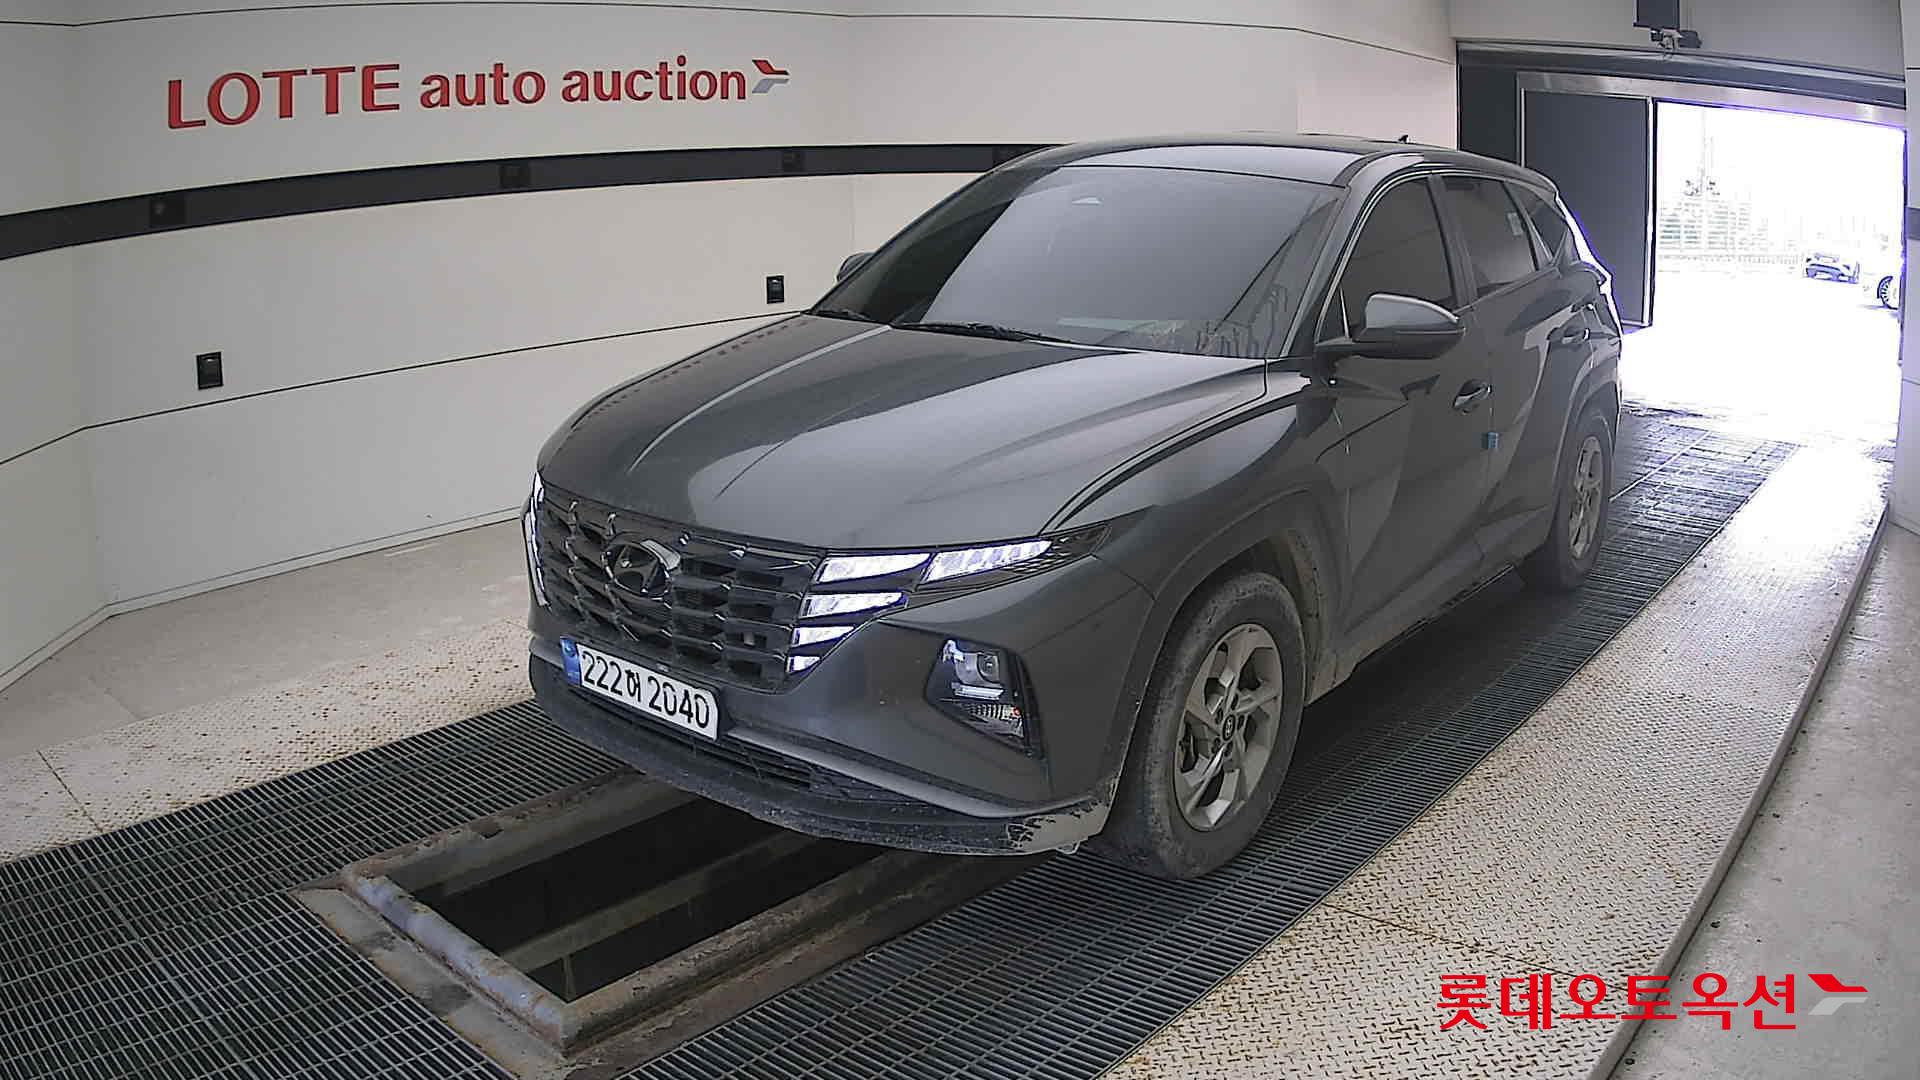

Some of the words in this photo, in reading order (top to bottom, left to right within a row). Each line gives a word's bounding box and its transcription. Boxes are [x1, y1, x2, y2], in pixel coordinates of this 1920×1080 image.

[168, 63, 400, 129] LOTTE
[419, 63, 546, 108] auto
[561, 55, 747, 103] auction
[582, 651, 641, 702] 222허
[648, 676, 710, 729] 2040
